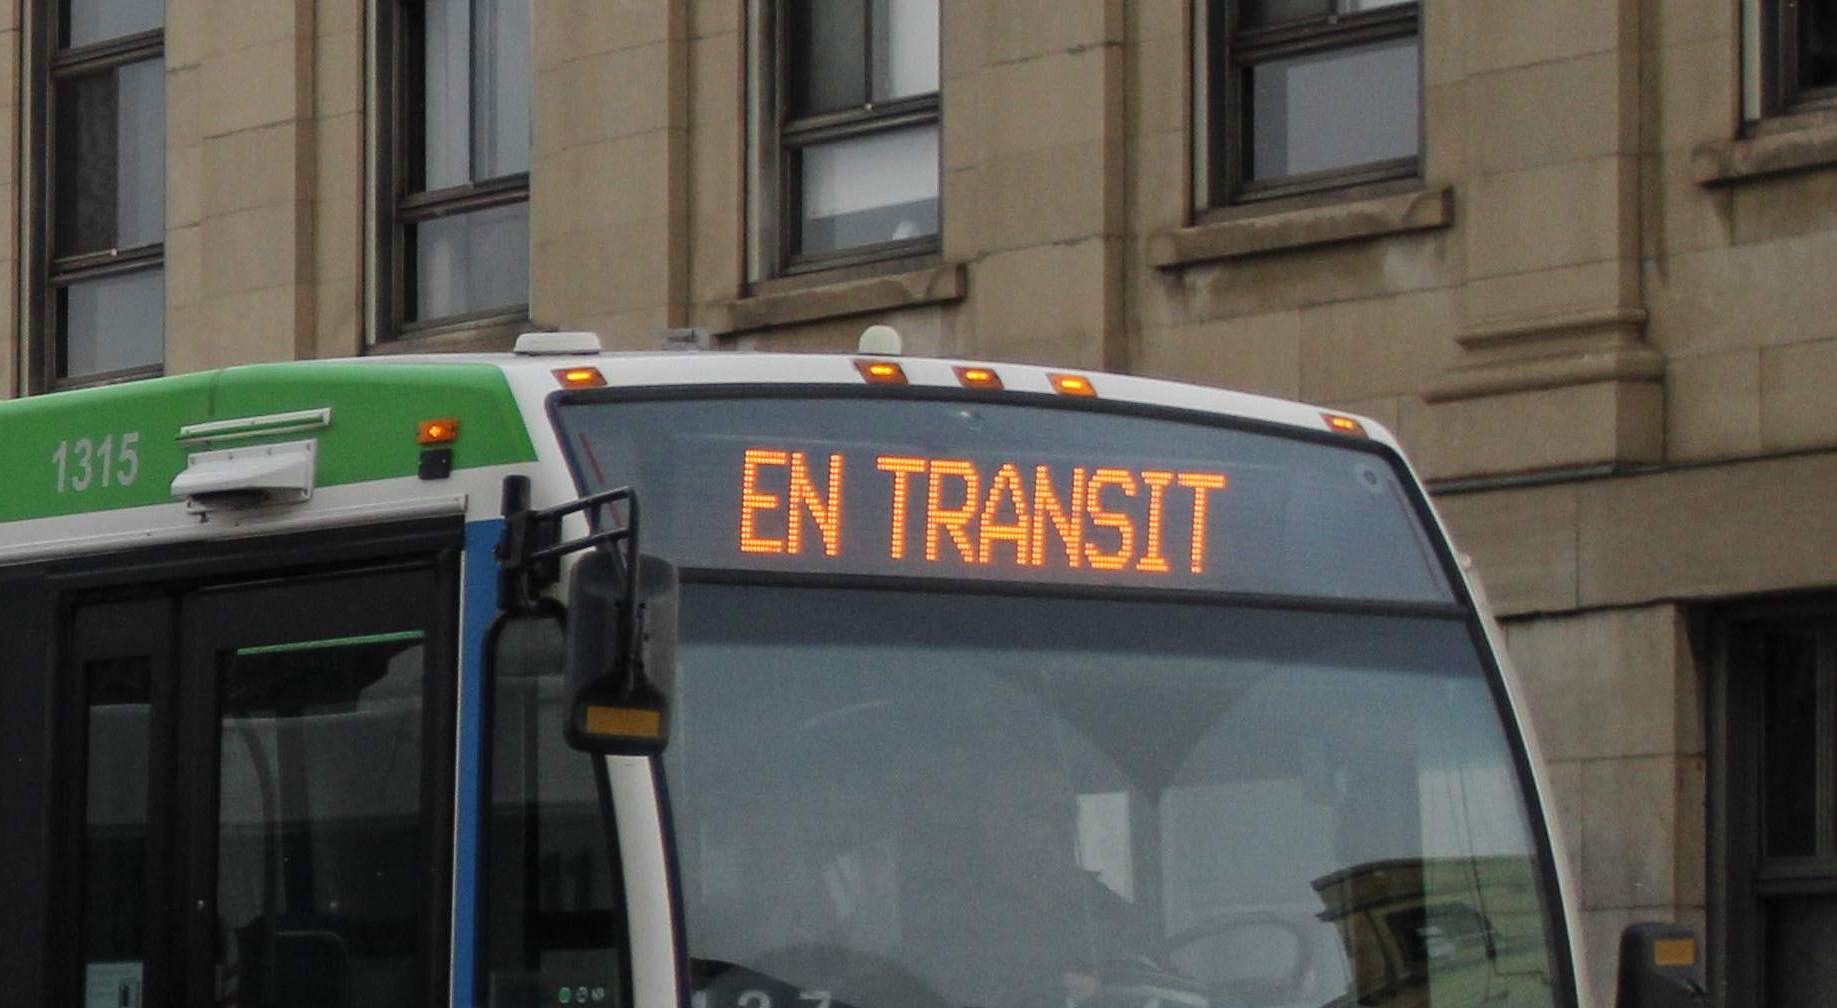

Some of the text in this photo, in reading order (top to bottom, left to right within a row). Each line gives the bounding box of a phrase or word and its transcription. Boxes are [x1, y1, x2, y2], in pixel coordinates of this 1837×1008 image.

[52, 431, 140, 494] 1315
[739, 448, 1227, 574] EN TRANSIT
